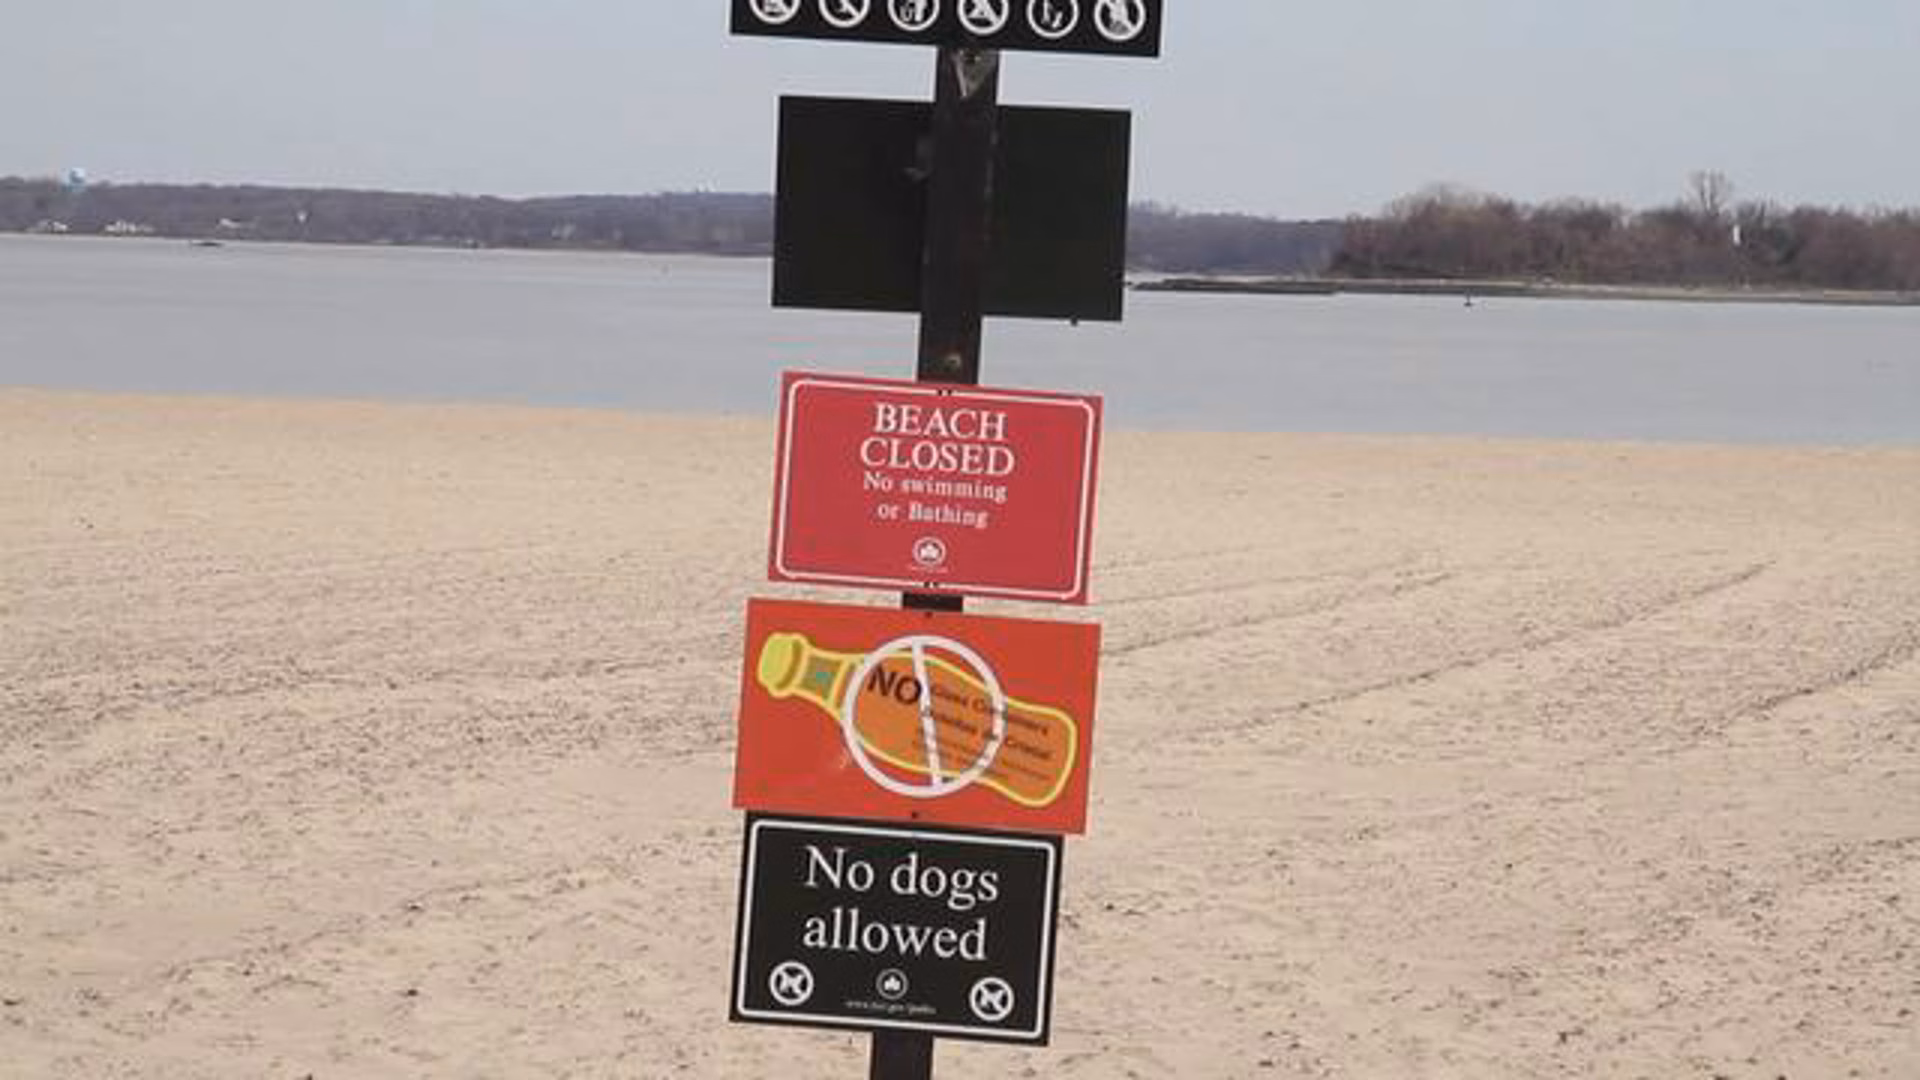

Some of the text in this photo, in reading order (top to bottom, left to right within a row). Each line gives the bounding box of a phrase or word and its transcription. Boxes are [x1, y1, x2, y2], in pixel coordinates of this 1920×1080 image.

[873, 402, 1008, 441] BEACH
[860, 437, 1016, 475] CLOSED
[863, 471, 1008, 504] No swimming
[878, 501, 989, 529] or Bathing
[866, 662, 923, 705] NO
[803, 845, 999, 911] No dogs
[803, 906, 988, 961] allowed
